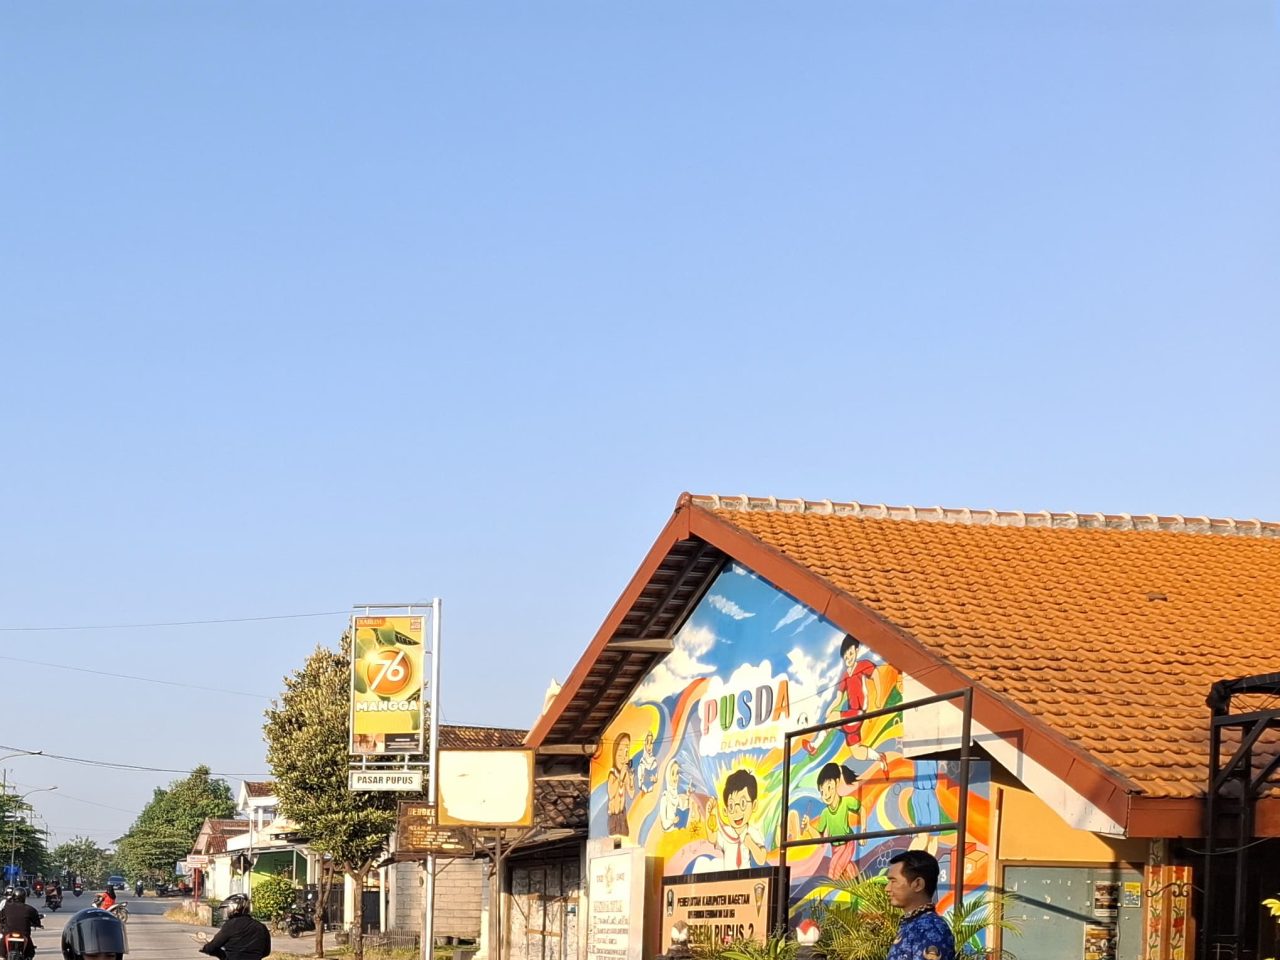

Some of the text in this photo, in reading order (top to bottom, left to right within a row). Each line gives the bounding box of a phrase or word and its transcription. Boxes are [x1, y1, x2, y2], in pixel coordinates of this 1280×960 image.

[370, 650, 405, 689] 76
[355, 700, 418, 712] MANGGA
[703, 679, 789, 735] PUSDA
[357, 776, 413, 784] PASAR PUPUS
[939, 868, 947, 881] 3
